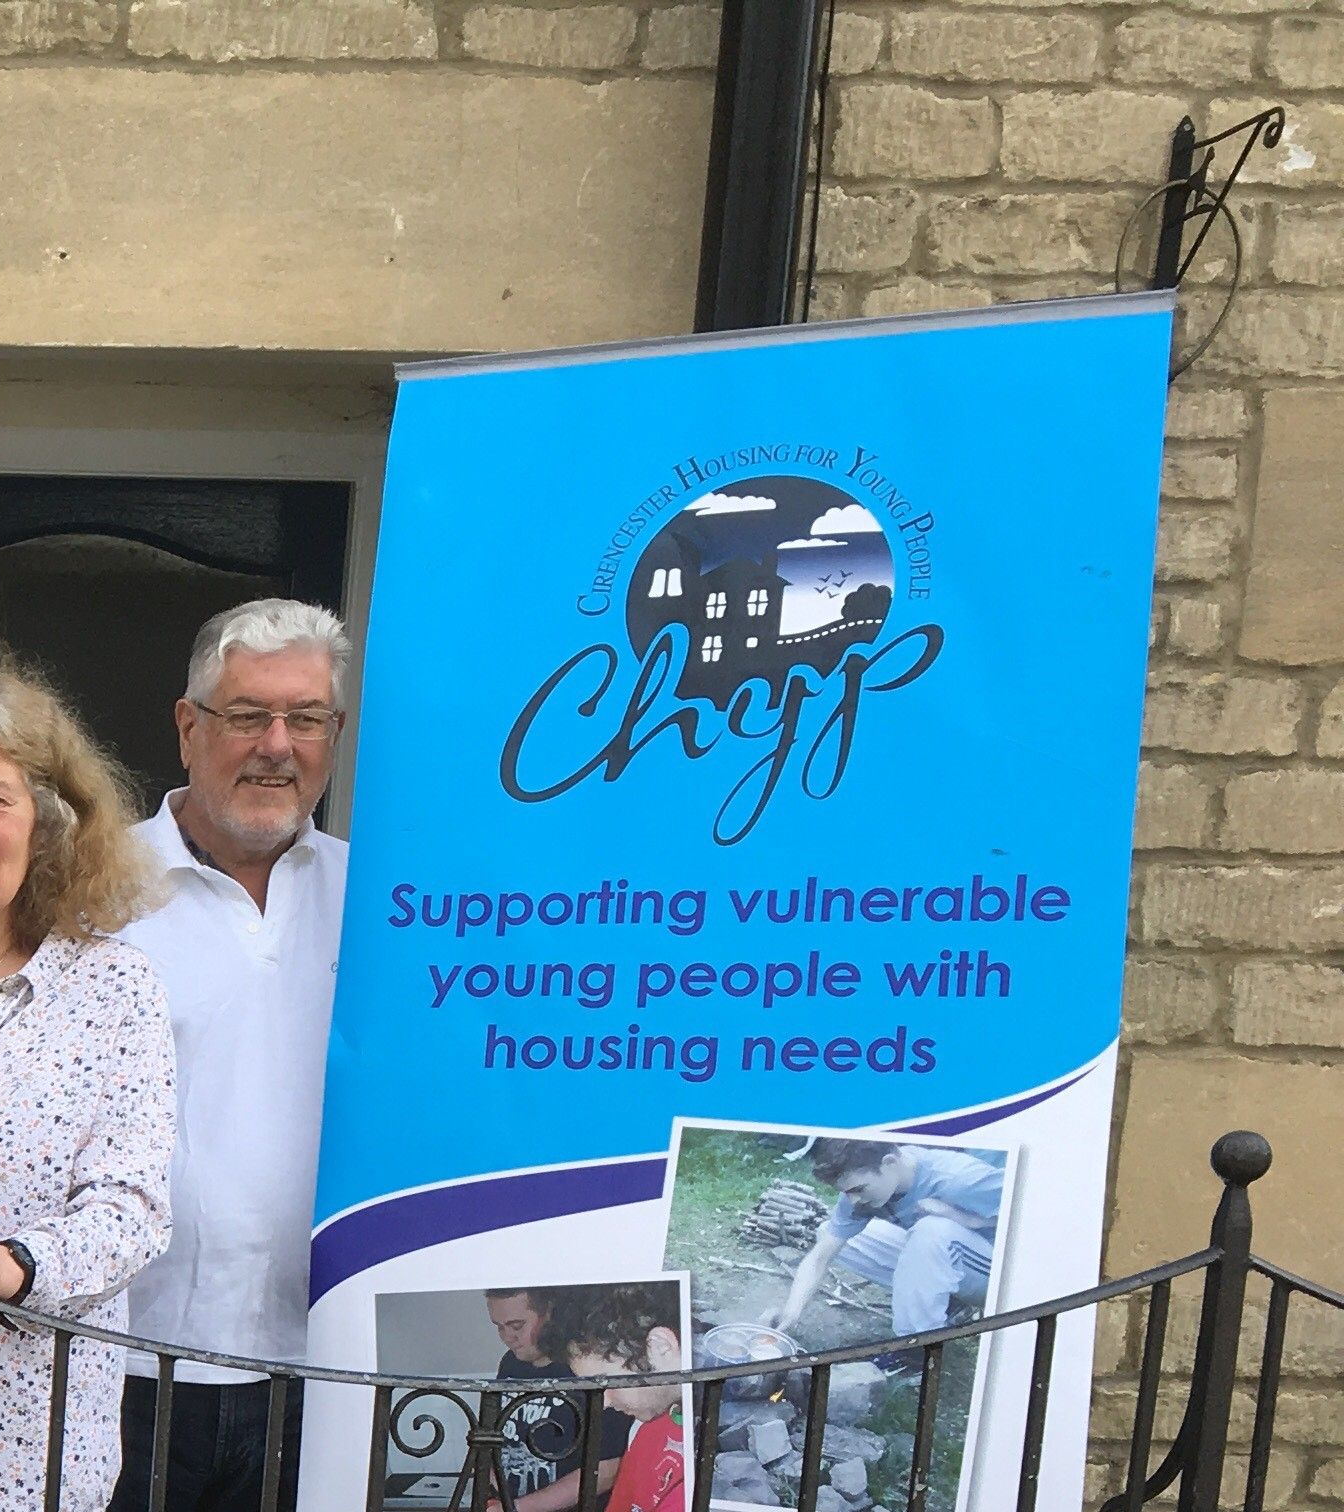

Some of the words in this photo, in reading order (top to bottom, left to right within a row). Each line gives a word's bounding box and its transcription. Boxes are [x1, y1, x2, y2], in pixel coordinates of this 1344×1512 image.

[672, 444, 791, 492] HOUSING
[845, 446, 915, 521] YOUNG
[898, 510, 936, 602] PEOPLE
[499, 624, 945, 847] Chyp
[388, 879, 708, 938] Supporting
[728, 873, 1072, 928] vulnerable
[428, 956, 616, 1011] young
[636, 951, 862, 1010] people
[883, 948, 1012, 1001] with
[484, 1023, 719, 1082] housing
[741, 1026, 938, 1075] needs
